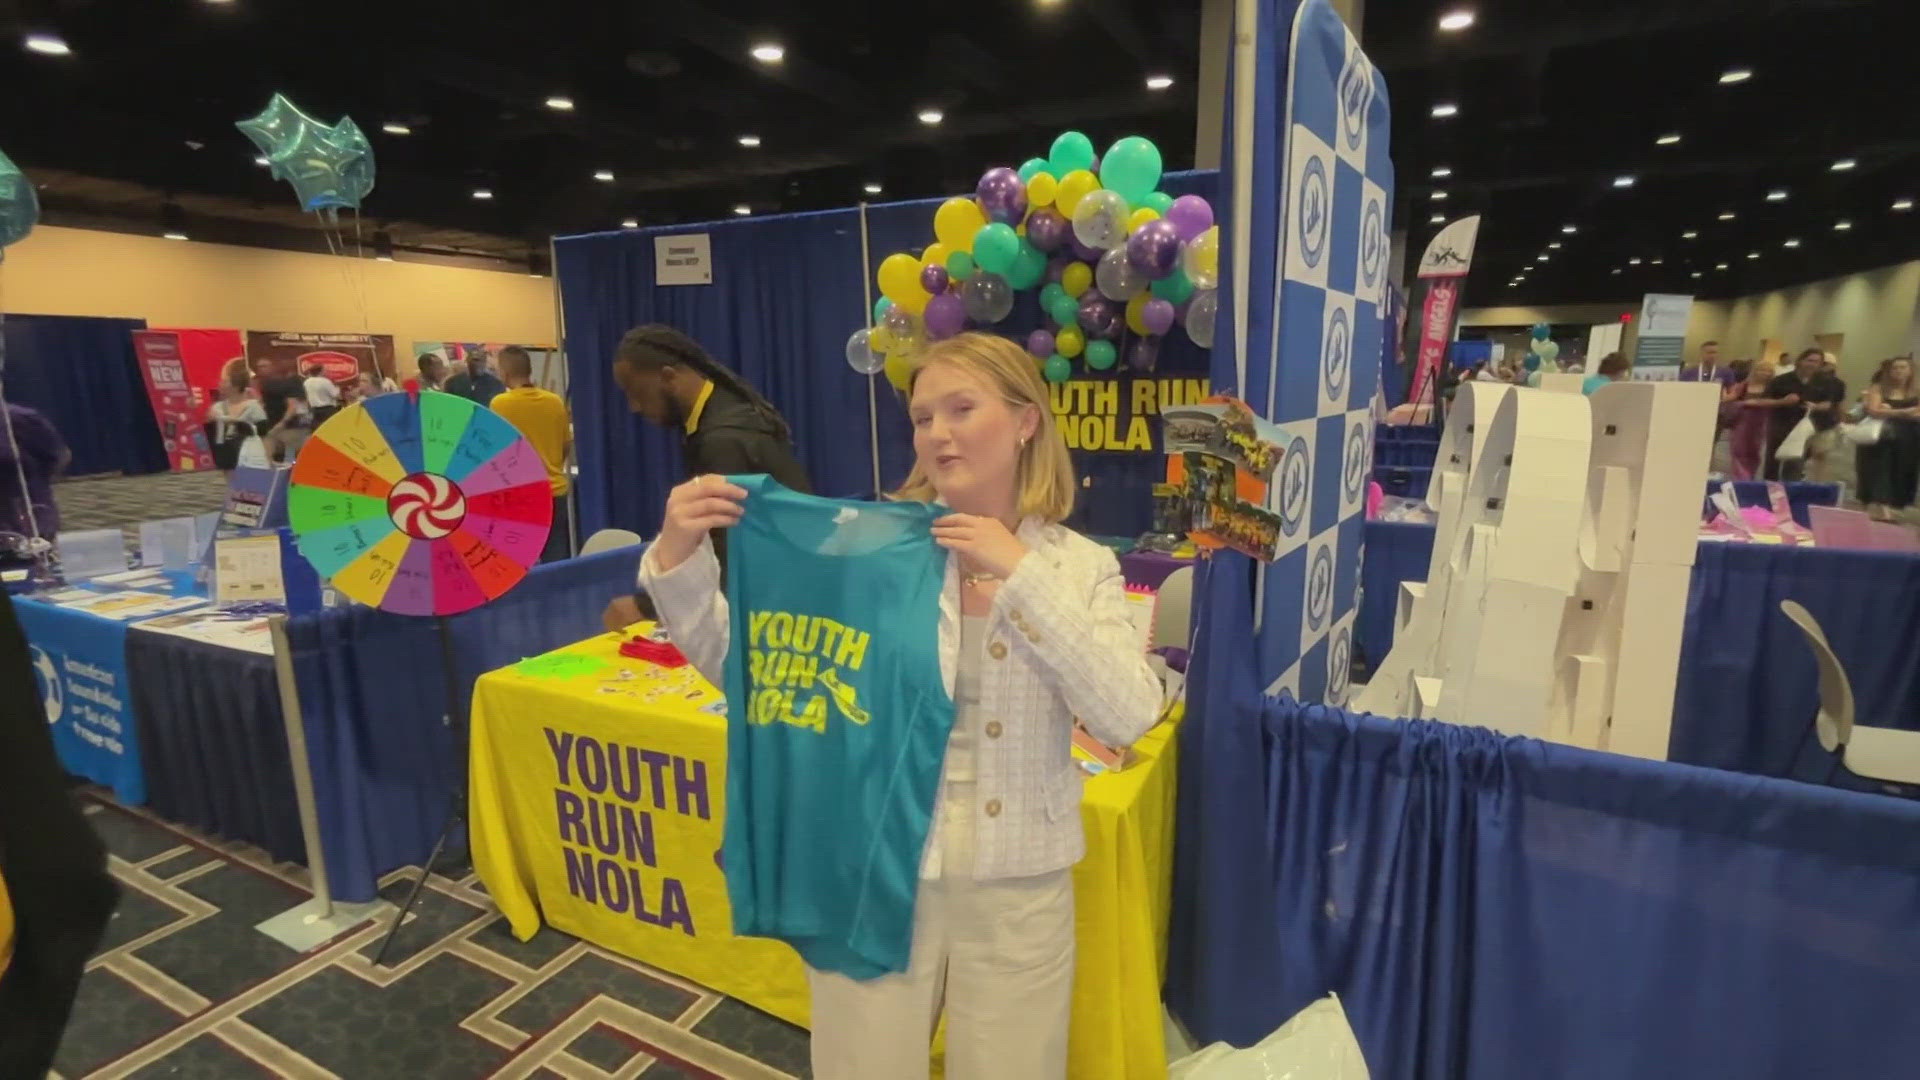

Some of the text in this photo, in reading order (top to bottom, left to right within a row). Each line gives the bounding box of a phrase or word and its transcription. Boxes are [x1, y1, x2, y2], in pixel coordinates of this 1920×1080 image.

[1050, 379, 1211, 415] UTH RUN
[1055, 415, 1152, 451] NOLA
[749, 611, 870, 670] YOUTH
[544, 727, 711, 820] YOUTH
[555, 788, 657, 867] RUN
[563, 846, 696, 937] NOLA
